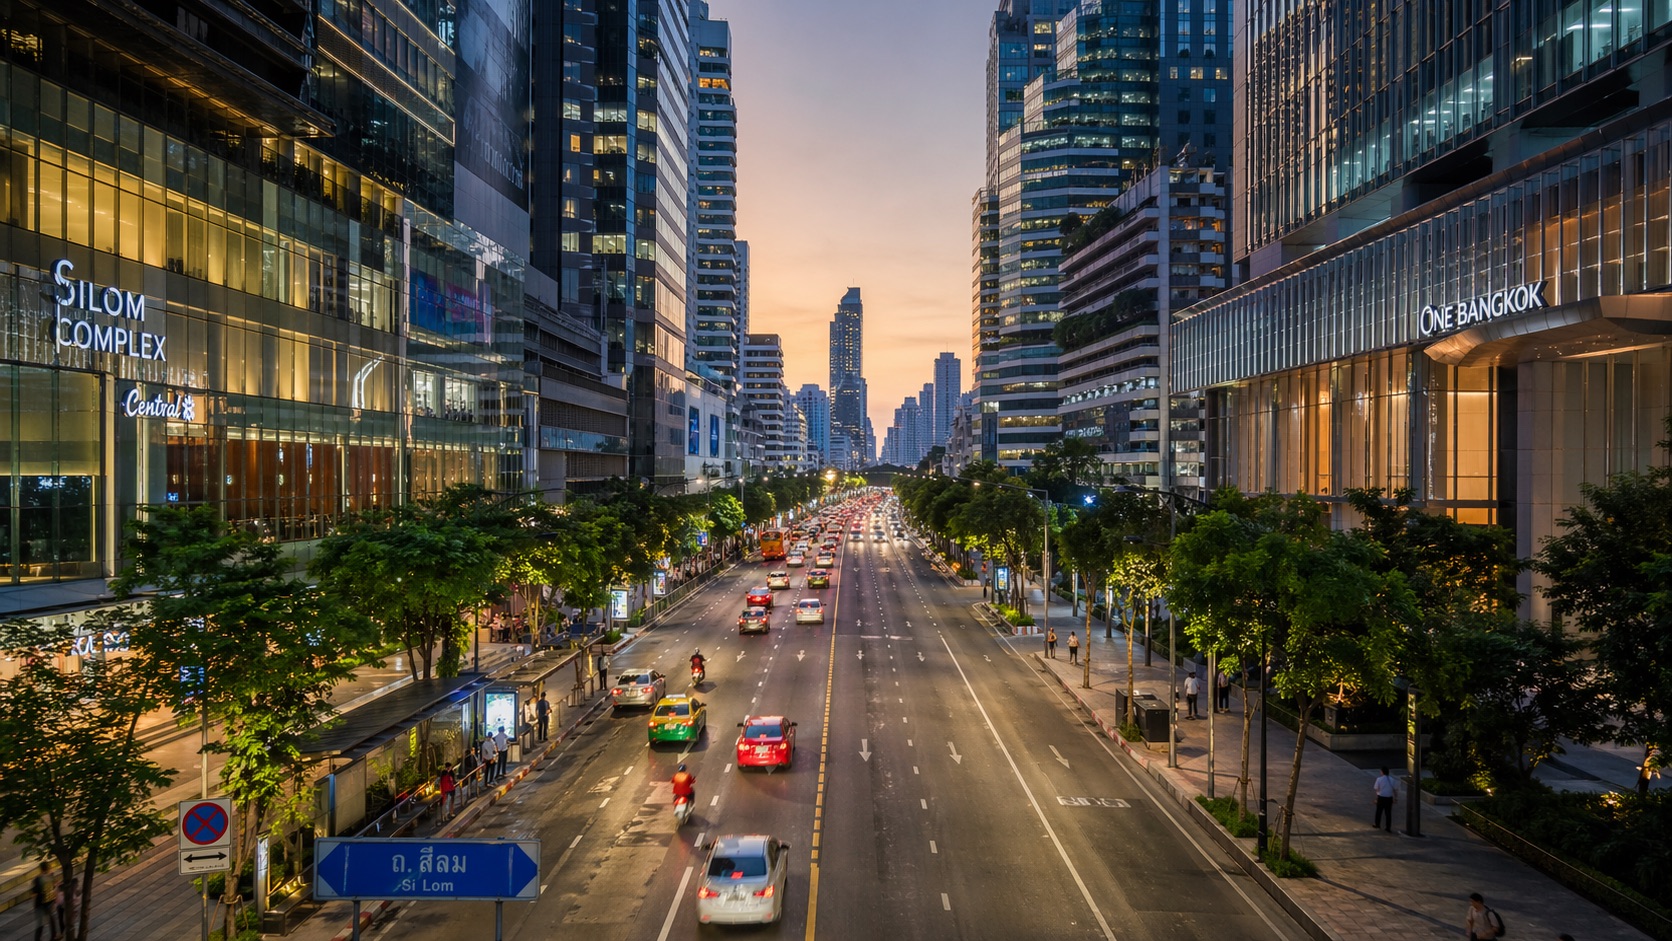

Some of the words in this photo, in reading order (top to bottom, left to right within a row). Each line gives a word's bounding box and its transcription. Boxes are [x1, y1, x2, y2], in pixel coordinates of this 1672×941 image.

[55, 259, 145, 322] SILOM
[1420, 305, 1453, 335] ONE
[1457, 281, 1543, 326] BANGKOK
[57, 317, 167, 362] COMPLEX
[125, 388, 181, 418] Central
[392, 854, 412, 873] ถ.
[419, 846, 467, 873] สีลม
[401, 878, 416, 892] Si
[422, 879, 454, 892] Lom
